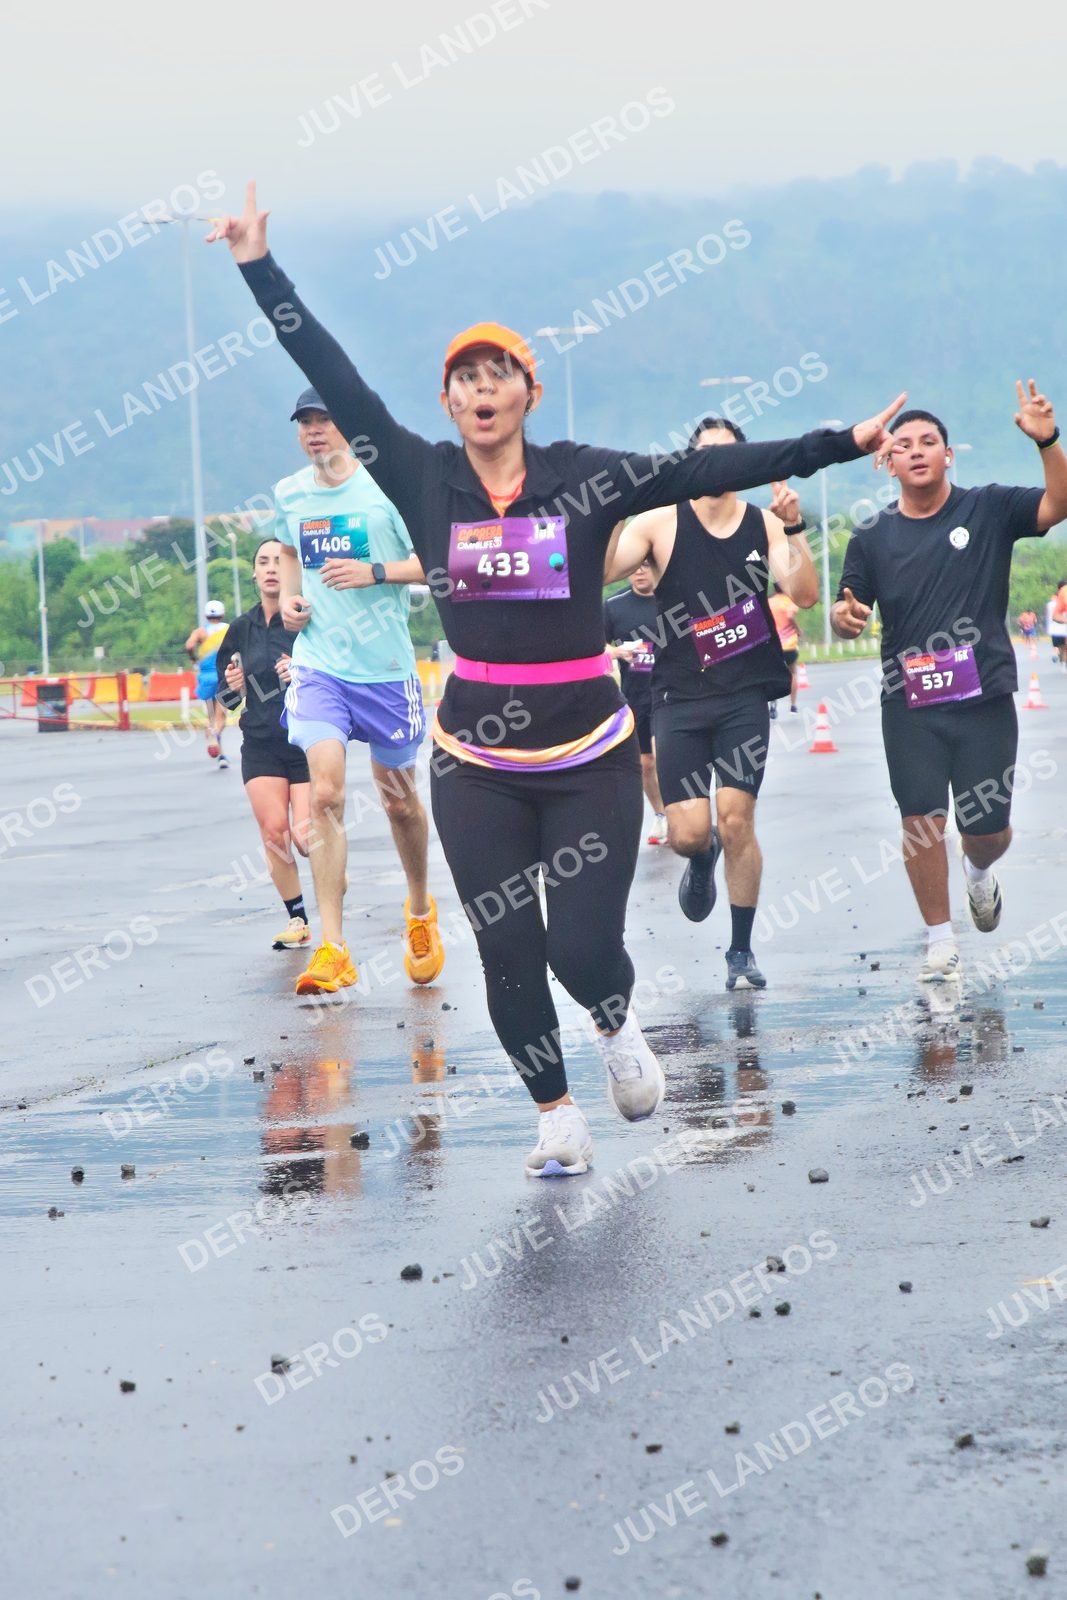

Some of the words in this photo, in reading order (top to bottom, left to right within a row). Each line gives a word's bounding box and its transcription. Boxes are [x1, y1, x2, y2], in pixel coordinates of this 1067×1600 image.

[458, 525, 503, 541] CARRERA
[311, 535, 351, 553] 1406
[477, 551, 530, 577] 433
[714, 624, 748, 648] 539
[921, 671, 953, 690] 537
